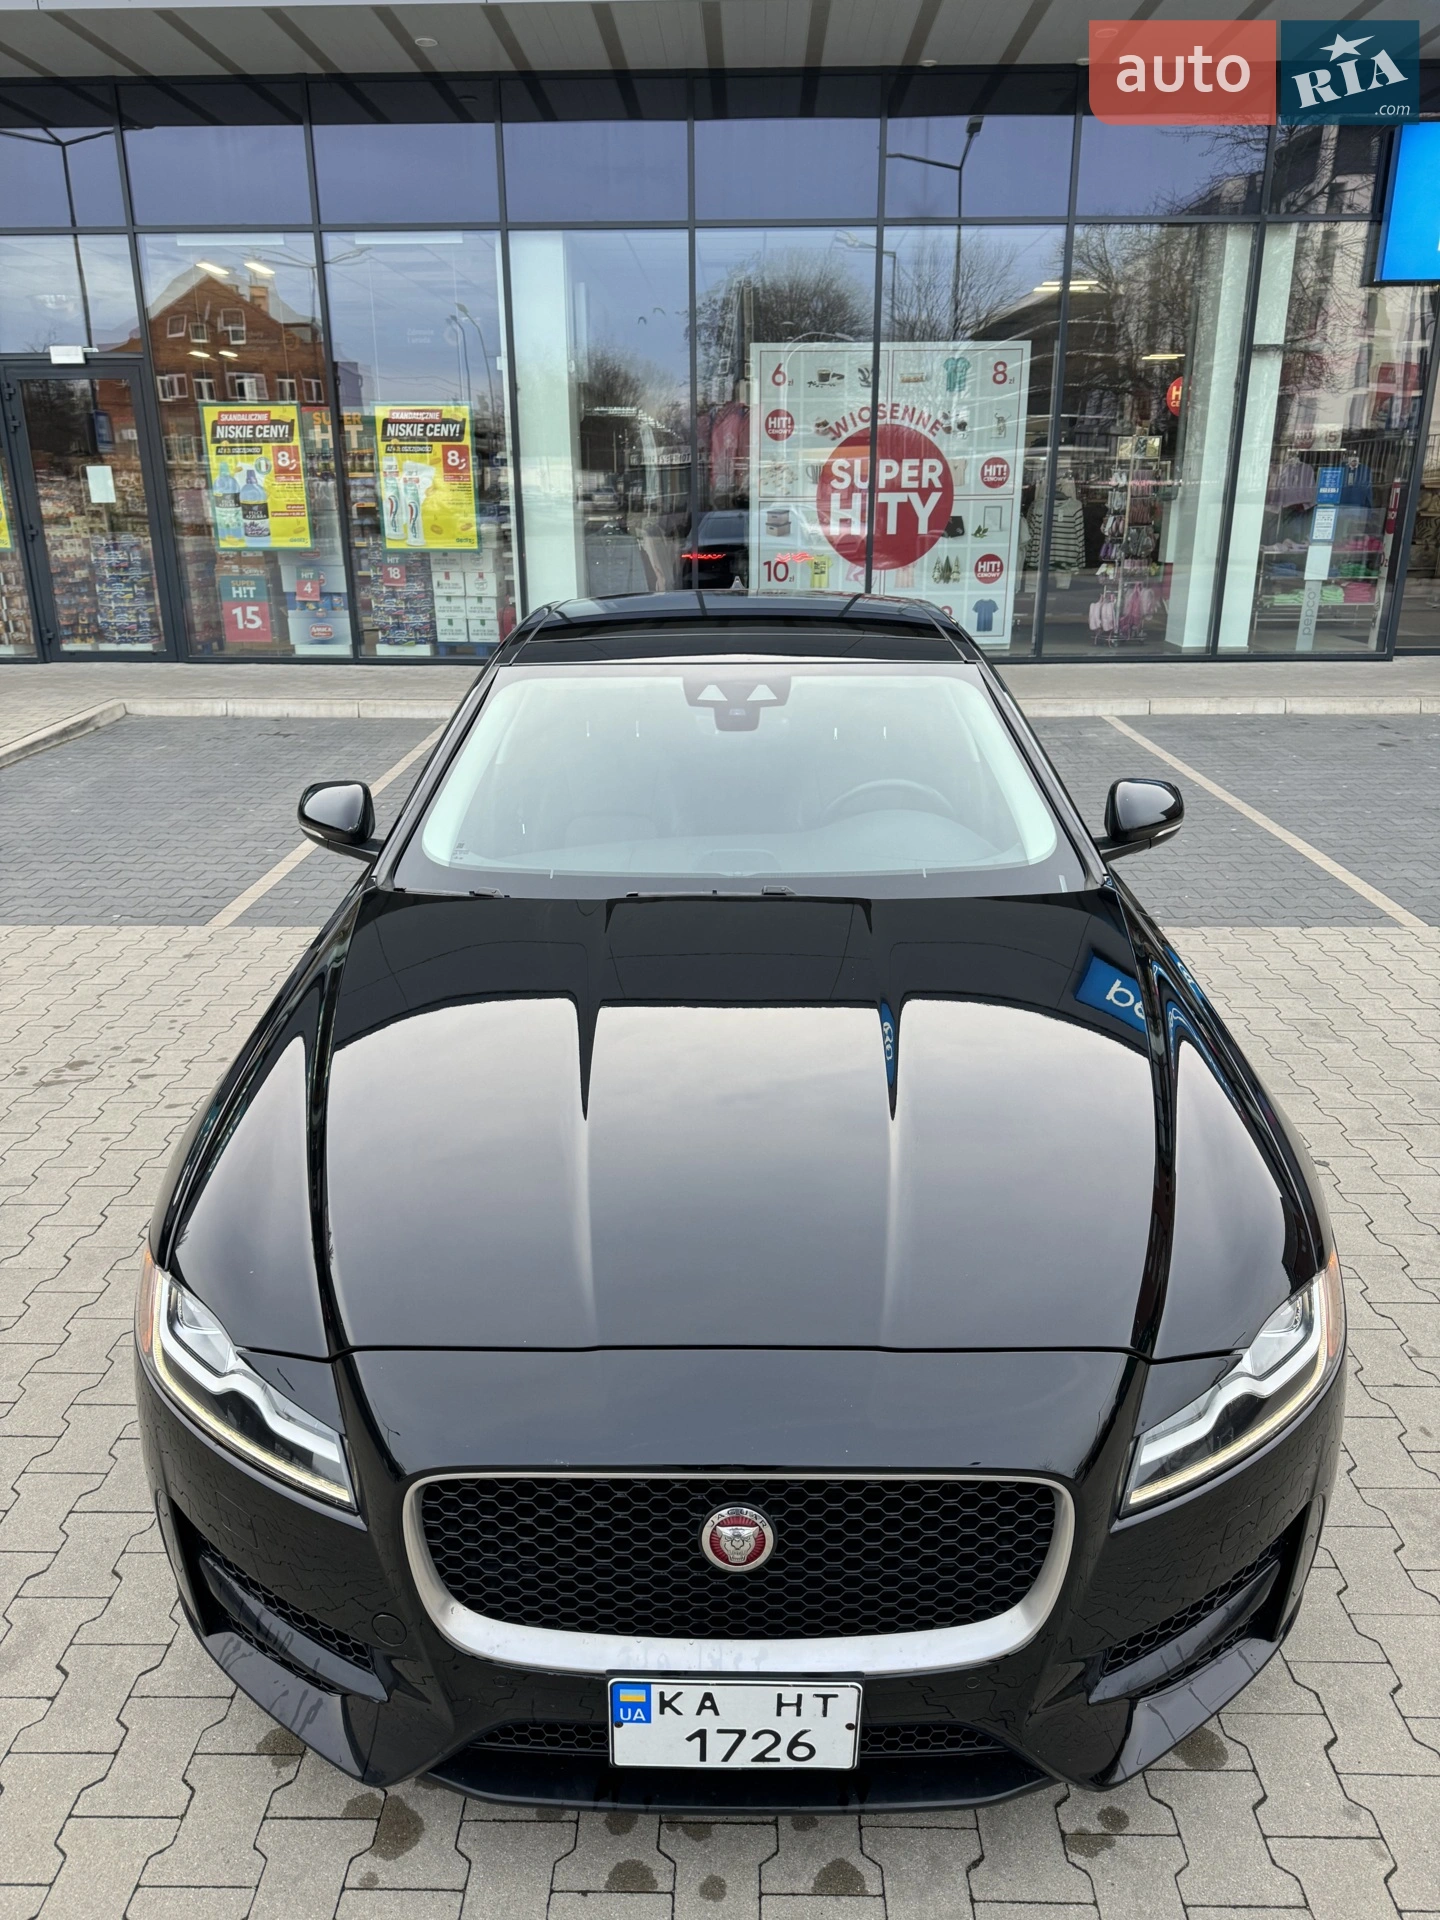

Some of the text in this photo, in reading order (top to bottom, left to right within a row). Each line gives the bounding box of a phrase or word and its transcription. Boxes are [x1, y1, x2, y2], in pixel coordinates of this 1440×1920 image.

[771, 362, 786, 386] 6
[992, 361, 1008, 385] 8
[220, 413, 269, 422] SKANDALICZNIE
[312, 411, 363, 425] SUER
[768, 417, 791, 429] HIT!
[828, 402, 944, 439] WIOSENNE
[216, 424, 289, 439] NISKIE CENY!
[314, 425, 364, 449] HT
[386, 423, 460, 437] NISKIE CENY!
[830, 458, 943, 490] SUPER
[984, 464, 1007, 476] HIT!
[387, 567, 400, 579] 18
[763, 561, 789, 582] 10
[977, 561, 1001, 572] HIT!
[303, 582, 313, 594] 4
[231, 606, 262, 630] 15
[1302, 591, 1316, 636] pepco
[710, 1508, 767, 1528] JAGUAR
[658, 1691, 839, 1717] KA HT
[619, 1708, 646, 1721] UA
[684, 1728, 817, 1763] 1726
